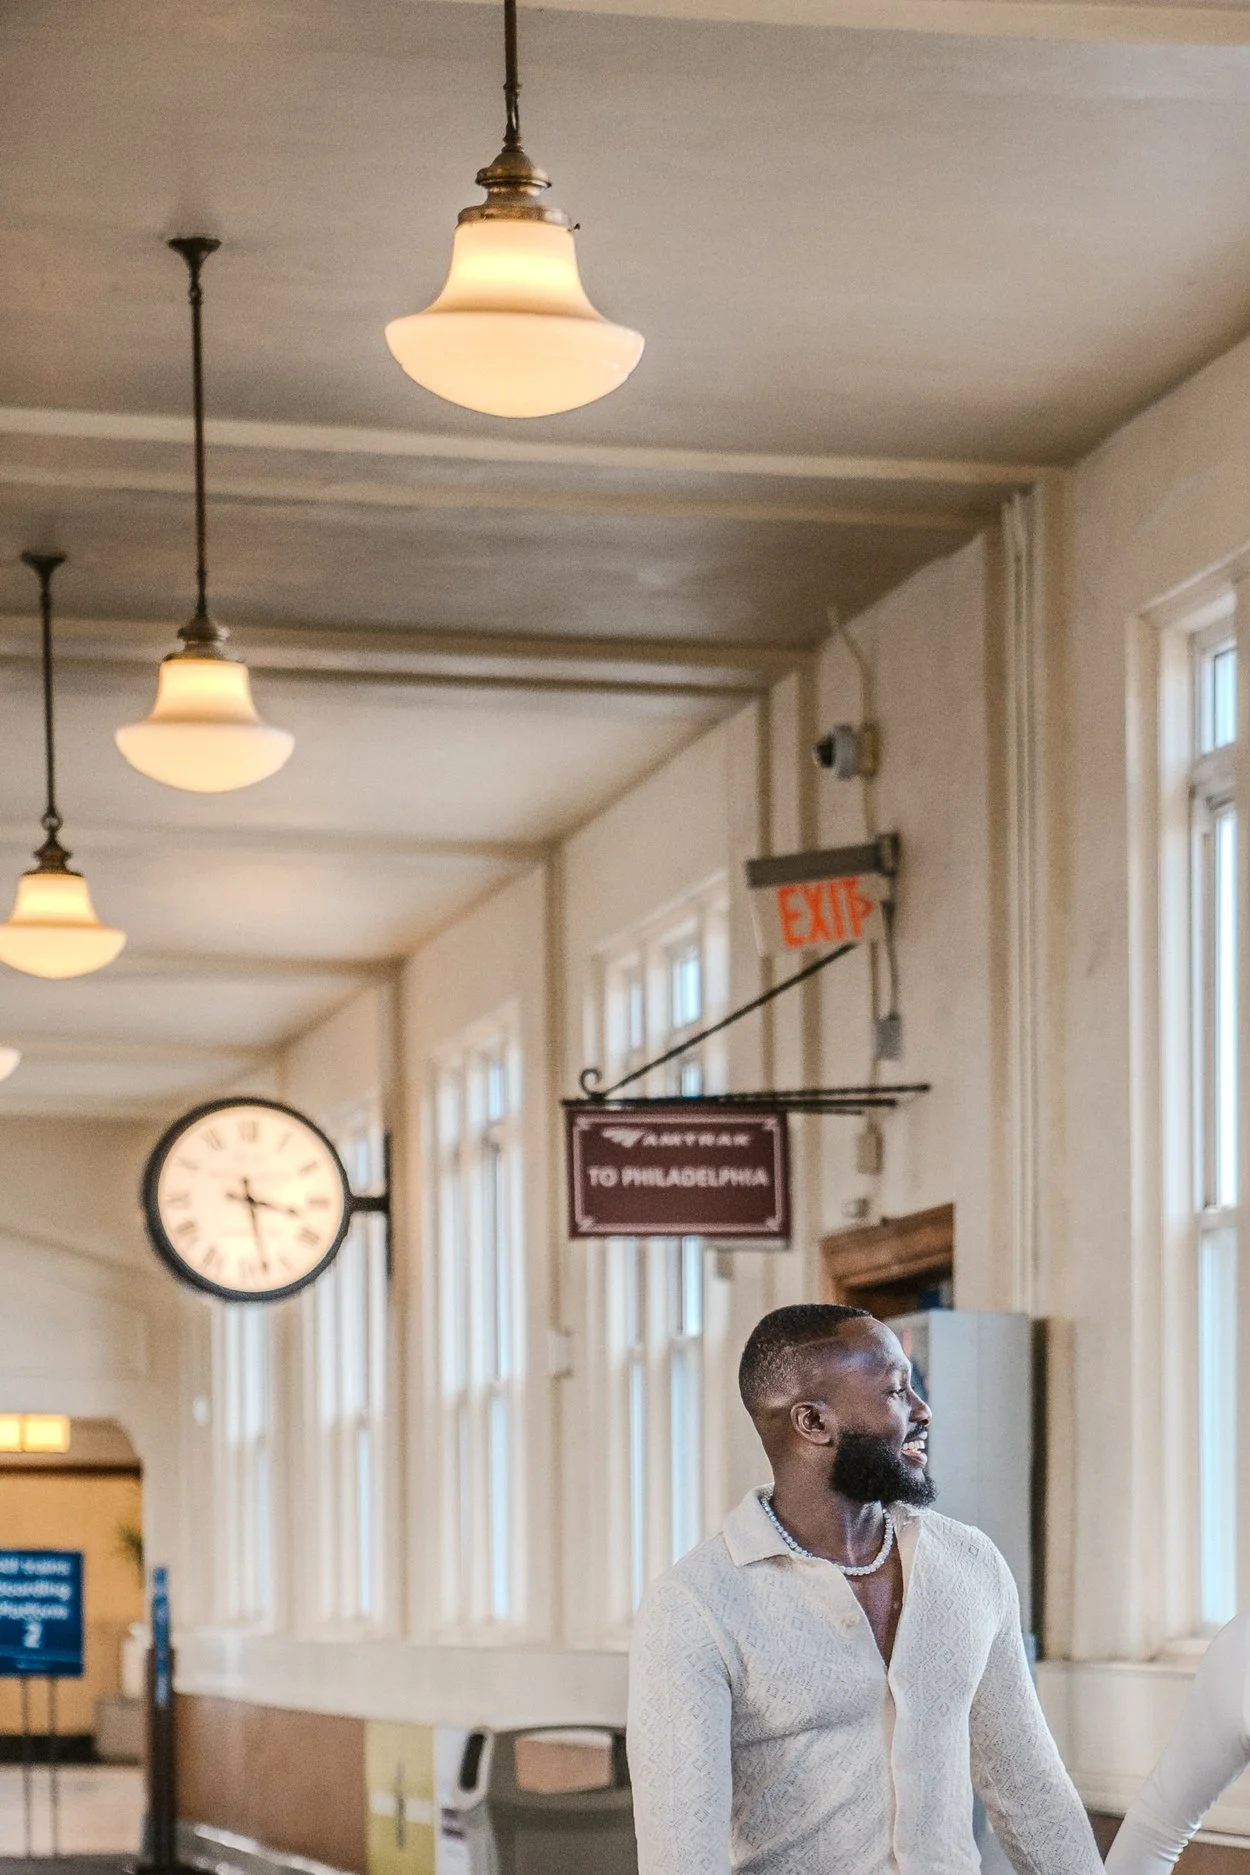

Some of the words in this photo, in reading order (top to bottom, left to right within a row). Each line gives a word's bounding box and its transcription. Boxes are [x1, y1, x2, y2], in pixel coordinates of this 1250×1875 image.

[777, 875, 861, 948] EXIT
[642, 1131, 750, 1147] AMTRAK
[587, 1165, 618, 1188] TO
[621, 1165, 770, 1188] PHILADELPHIA
[23, 1621, 42, 1649] 2
